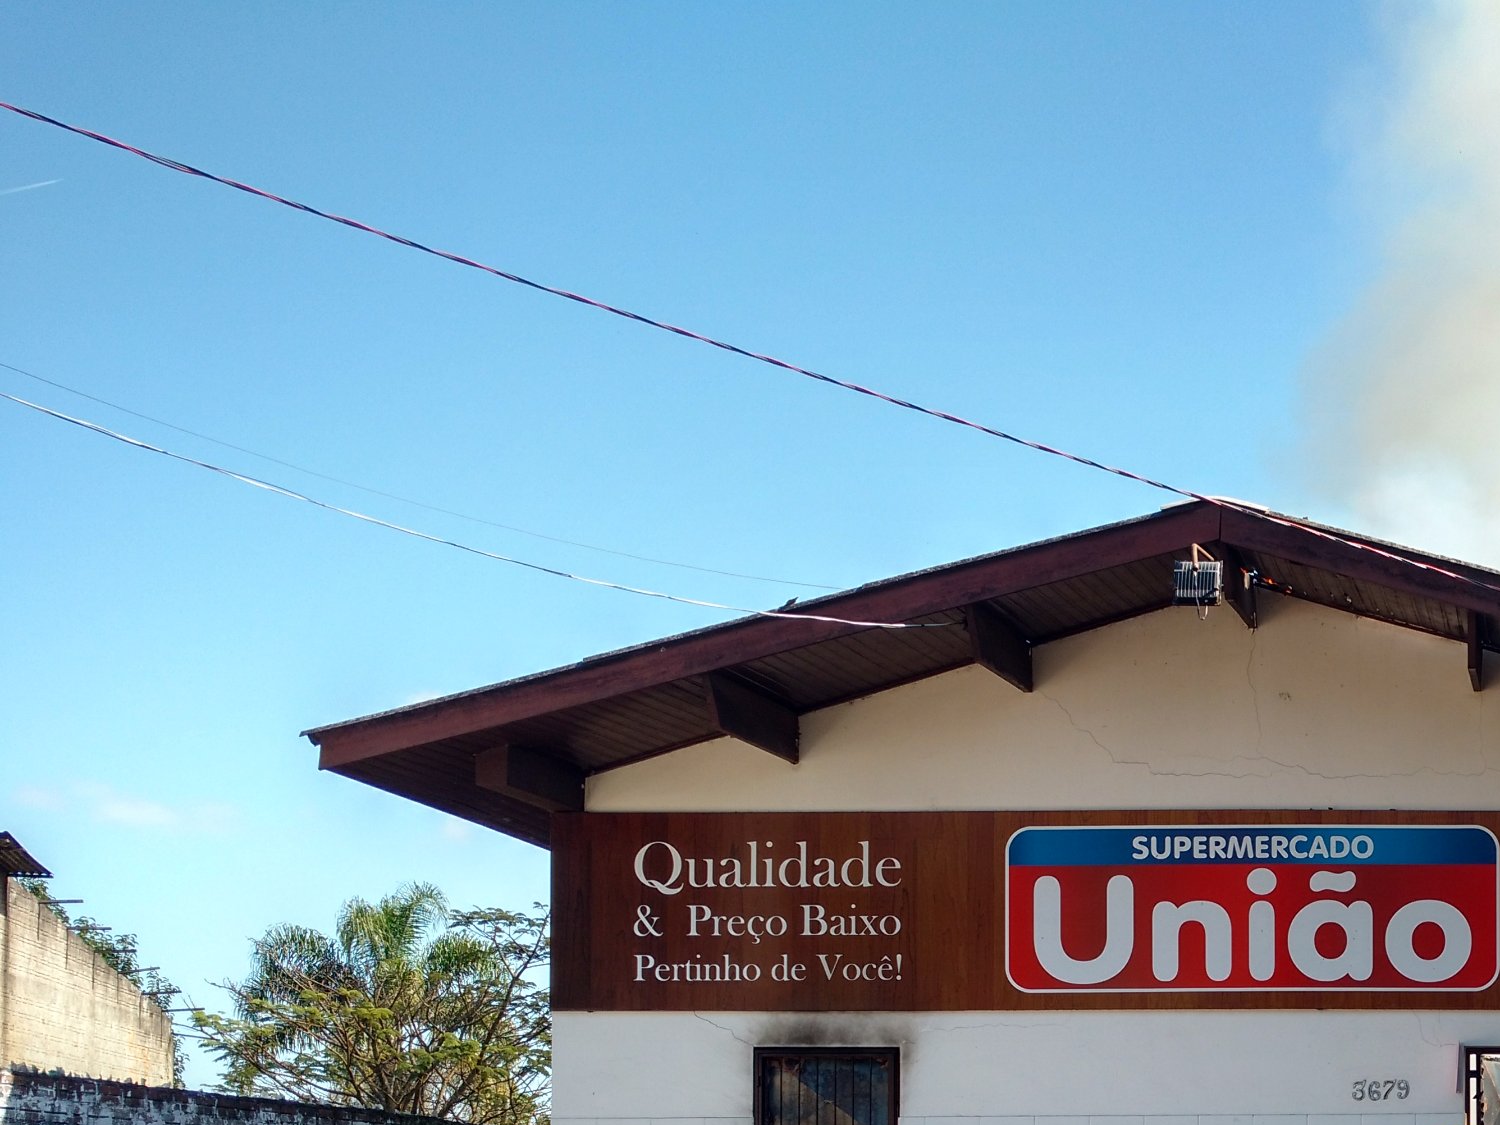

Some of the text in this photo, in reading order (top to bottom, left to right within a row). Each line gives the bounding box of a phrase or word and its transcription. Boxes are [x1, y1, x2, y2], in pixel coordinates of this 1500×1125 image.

[1132, 835, 1375, 860] SUPERMERCADO
[633, 840, 902, 895] Qualidade
[633, 904, 902, 944] & Preço Baixo
[1033, 867, 1473, 985] União
[633, 954, 903, 982] Pertinho de Você!
[1352, 1079, 1410, 1101] 3679
